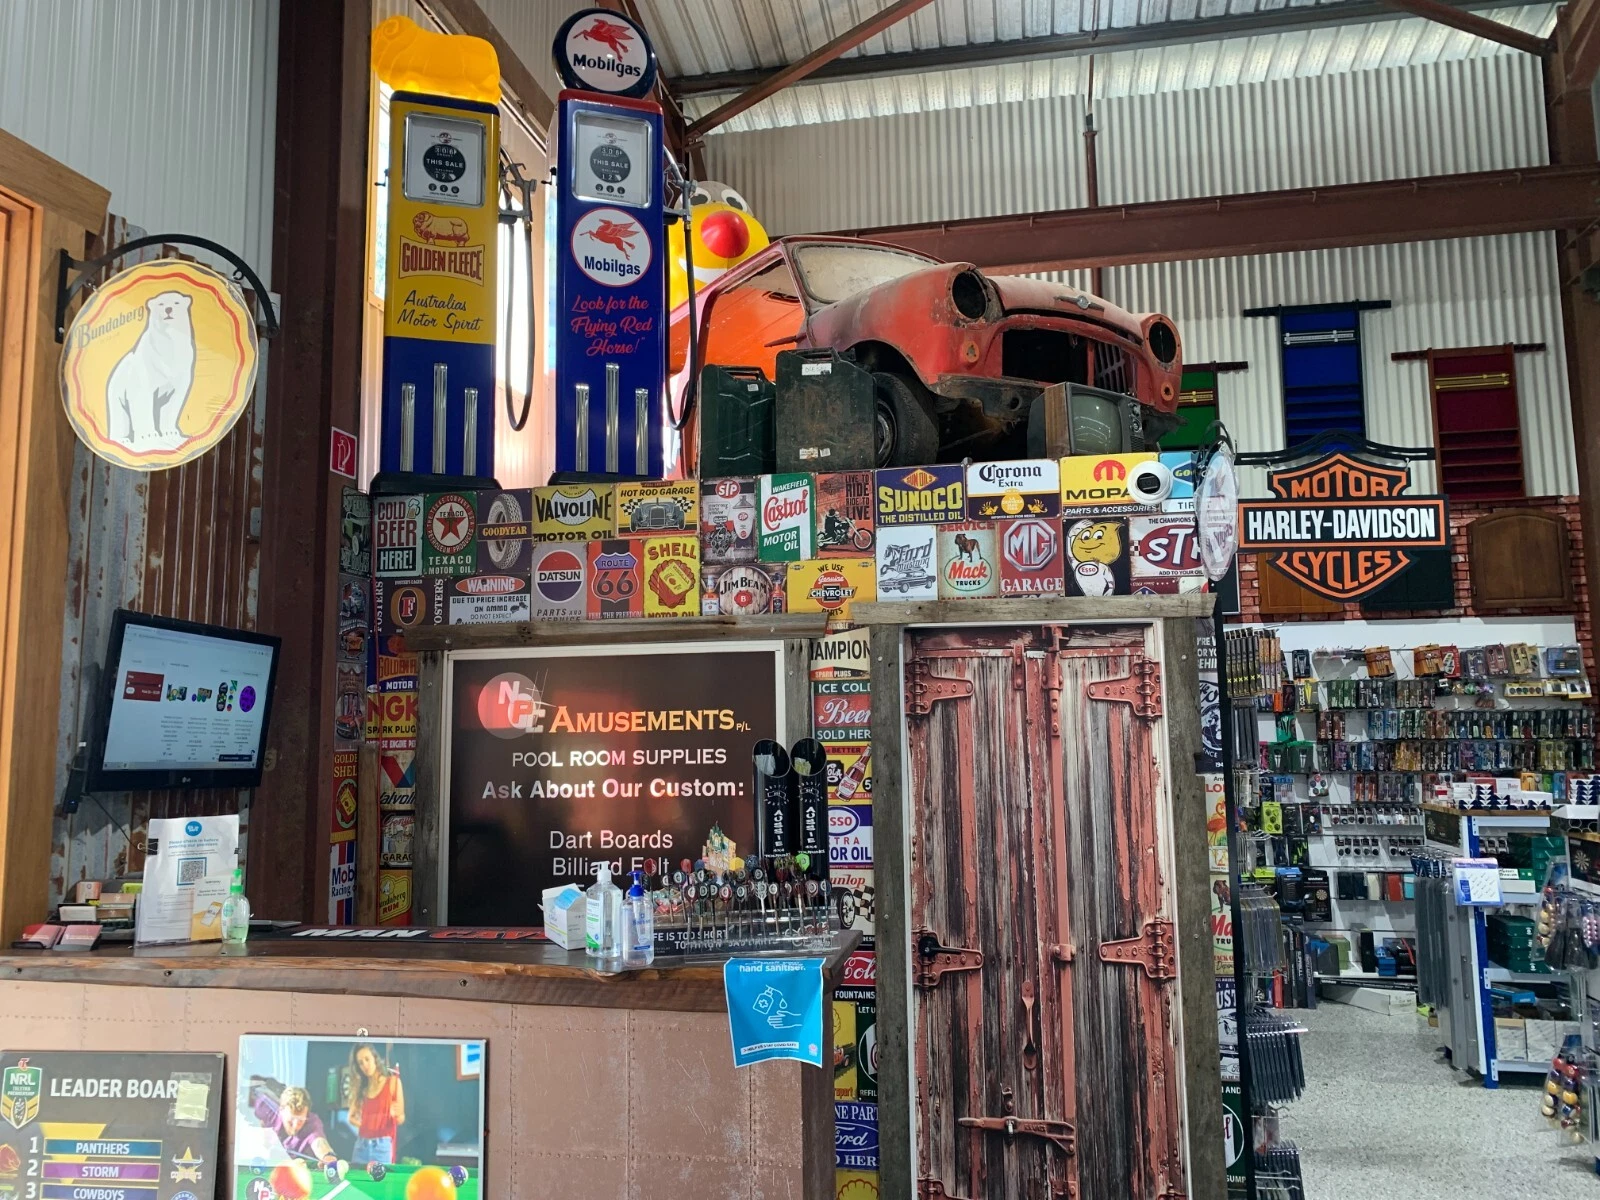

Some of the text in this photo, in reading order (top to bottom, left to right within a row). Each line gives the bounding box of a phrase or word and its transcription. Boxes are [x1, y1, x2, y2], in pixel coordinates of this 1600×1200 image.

[573, 54, 641, 79] Mobilgas
[593, 158, 629, 169] THIS SALE
[402, 249, 482, 280] GOLDEN FLEECE
[584, 256, 641, 277] Mobilgas
[403, 290, 467, 311] Australias
[571, 295, 649, 317] Look for the
[74, 305, 145, 349] Bundaberg
[397, 309, 484, 335] Motor Spirit
[571, 317, 652, 339] Flying Red
[845, 474, 870, 483] LIVE TO
[979, 464, 1042, 483] Corona
[1291, 464, 1389, 498] MOTOR
[718, 481, 738, 496] STP
[772, 479, 808, 493] WAKEFIELD
[845, 482, 870, 497] RIDE
[998, 479, 1023, 488] Extra
[620, 486, 695, 497] HOT ROD GARAGE
[878, 482, 963, 513] SUNOCO
[535, 491, 612, 523] VALVOLINE
[846, 497, 870, 506] RIDE TO
[1101, 504, 1157, 513] ACCESSORIES
[378, 501, 406, 520] COLD
[763, 489, 809, 531] Castrol
[846, 506, 871, 521] LIVE
[880, 511, 963, 523] THE DISTILLED OIL
[482, 526, 527, 537] GOODYEAR
[939, 522, 995, 532] SERVICE
[1248, 508, 1436, 541] HARLEY-DAVIDSON
[377, 520, 418, 548] BEER
[453, 528, 474, 553] PRODUCTS
[533, 530, 614, 543] MOTOR OIL
[763, 531, 797, 547] MOTOR
[648, 543, 697, 561] SHELL
[784, 542, 799, 552] OIL
[1009, 525, 1050, 566] MG
[380, 550, 413, 571] HERE!
[428, 555, 472, 565] TEXACO
[428, 565, 471, 575] MOTOR OIL
[539, 570, 581, 581] DATSUN
[818, 564, 844, 573] WE USE
[948, 561, 988, 580] Mack
[1292, 551, 1392, 590] CYCLES
[467, 579, 515, 593] WARNING
[596, 571, 638, 596] 66
[721, 576, 767, 594] JIM BEAM
[818, 575, 844, 584] Genuine
[1001, 577, 1064, 592] GARAGE
[402, 596, 416, 617] F
[433, 578, 444, 626] OSTER'S
[496, 595, 527, 603] INCREASE
[537, 609, 566, 617] PARTS
[834, 670, 852, 678] PLUGS
[386, 680, 413, 690] MOTOR
[818, 683, 838, 693] ICE
[367, 695, 418, 722] NGK
[395, 725, 416, 734] PLUG
[817, 730, 845, 740] SOLD
[512, 748, 727, 767] POOL ROOM SUPPLIES
[482, 778, 744, 799] Ask About Our Custom:
[773, 809, 784, 847] AUSSIE
[805, 806, 816, 844] AUSSIE
[550, 829, 673, 849] Dart Boards
[851, 847, 872, 860] OIL
[553, 857, 669, 876] Billiad Flt
[331, 884, 351, 897] Racing
[382, 903, 399, 914] RUM
[291, 928, 427, 938] MAN
[666, 932, 675, 940] IS
[739, 964, 806, 973] hand sanitiser.
[858, 1006, 870, 1014] LET
[10, 1072, 36, 1086] NRL
[50, 1078, 122, 1098] LEADER
[1225, 1086, 1241, 1095] AND
[29, 1137, 130, 1155] 1 PANTHERS
[26, 1160, 119, 1178] 2 STORM
[25, 1182, 125, 1200] 3 COWBOYS
